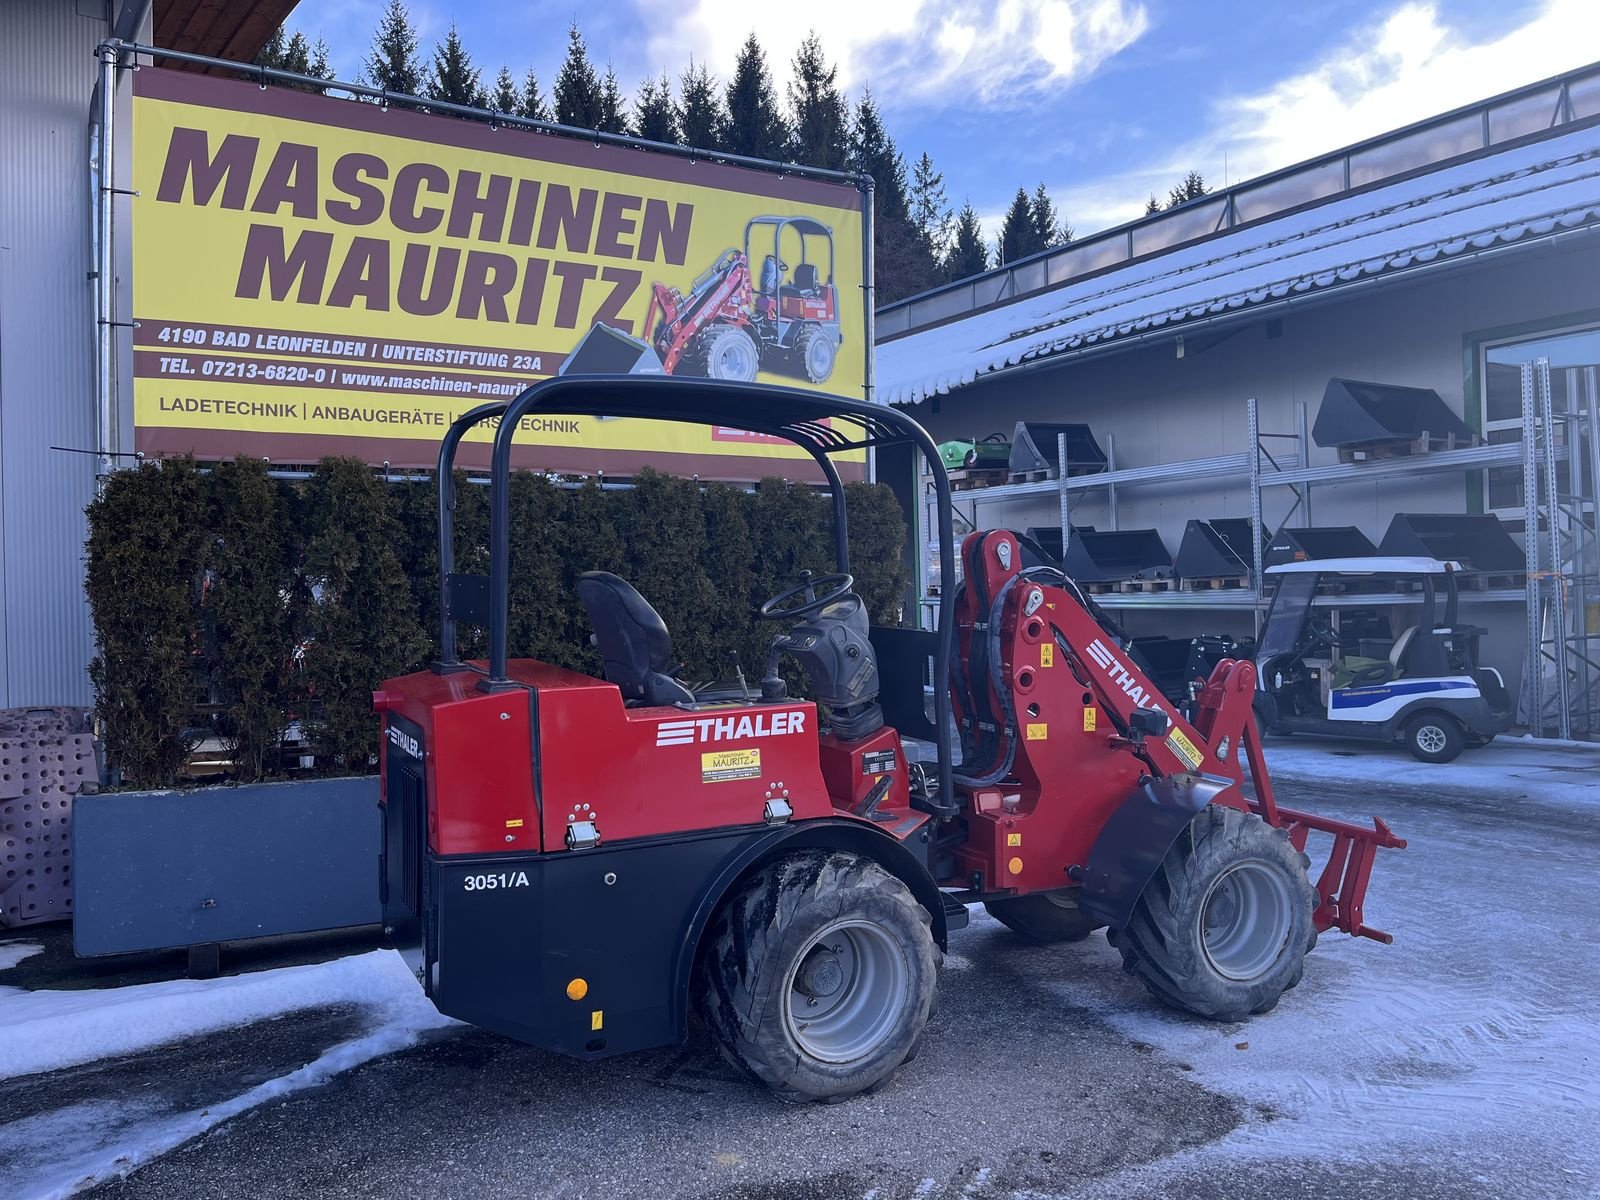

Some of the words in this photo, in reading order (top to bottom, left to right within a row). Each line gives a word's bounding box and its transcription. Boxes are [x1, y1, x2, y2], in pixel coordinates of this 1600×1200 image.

[156, 126, 694, 266] MASCHINEN
[234, 223, 643, 335] MAURITZ
[158, 327, 207, 345] 4190
[211, 330, 250, 348] BAD
[255, 334, 367, 357] LEONFELDEN
[382, 344, 508, 369] UNTERSTIFTUNG
[512, 355, 542, 370] 23A
[159, 357, 196, 374] TEL.
[202, 360, 326, 383] 07213-6820-0
[342, 372, 529, 396] www.maschinen-maurit
[159, 397, 298, 418] LADETECHNIK
[312, 405, 444, 426] ANBAUGERÄTE
[1108, 659, 1173, 727] THAL
[397, 729, 418, 759] THALER
[696, 711, 806, 742] THALER
[713, 756, 750, 767] MAURITZ
[464, 871, 530, 891] 3051/A
